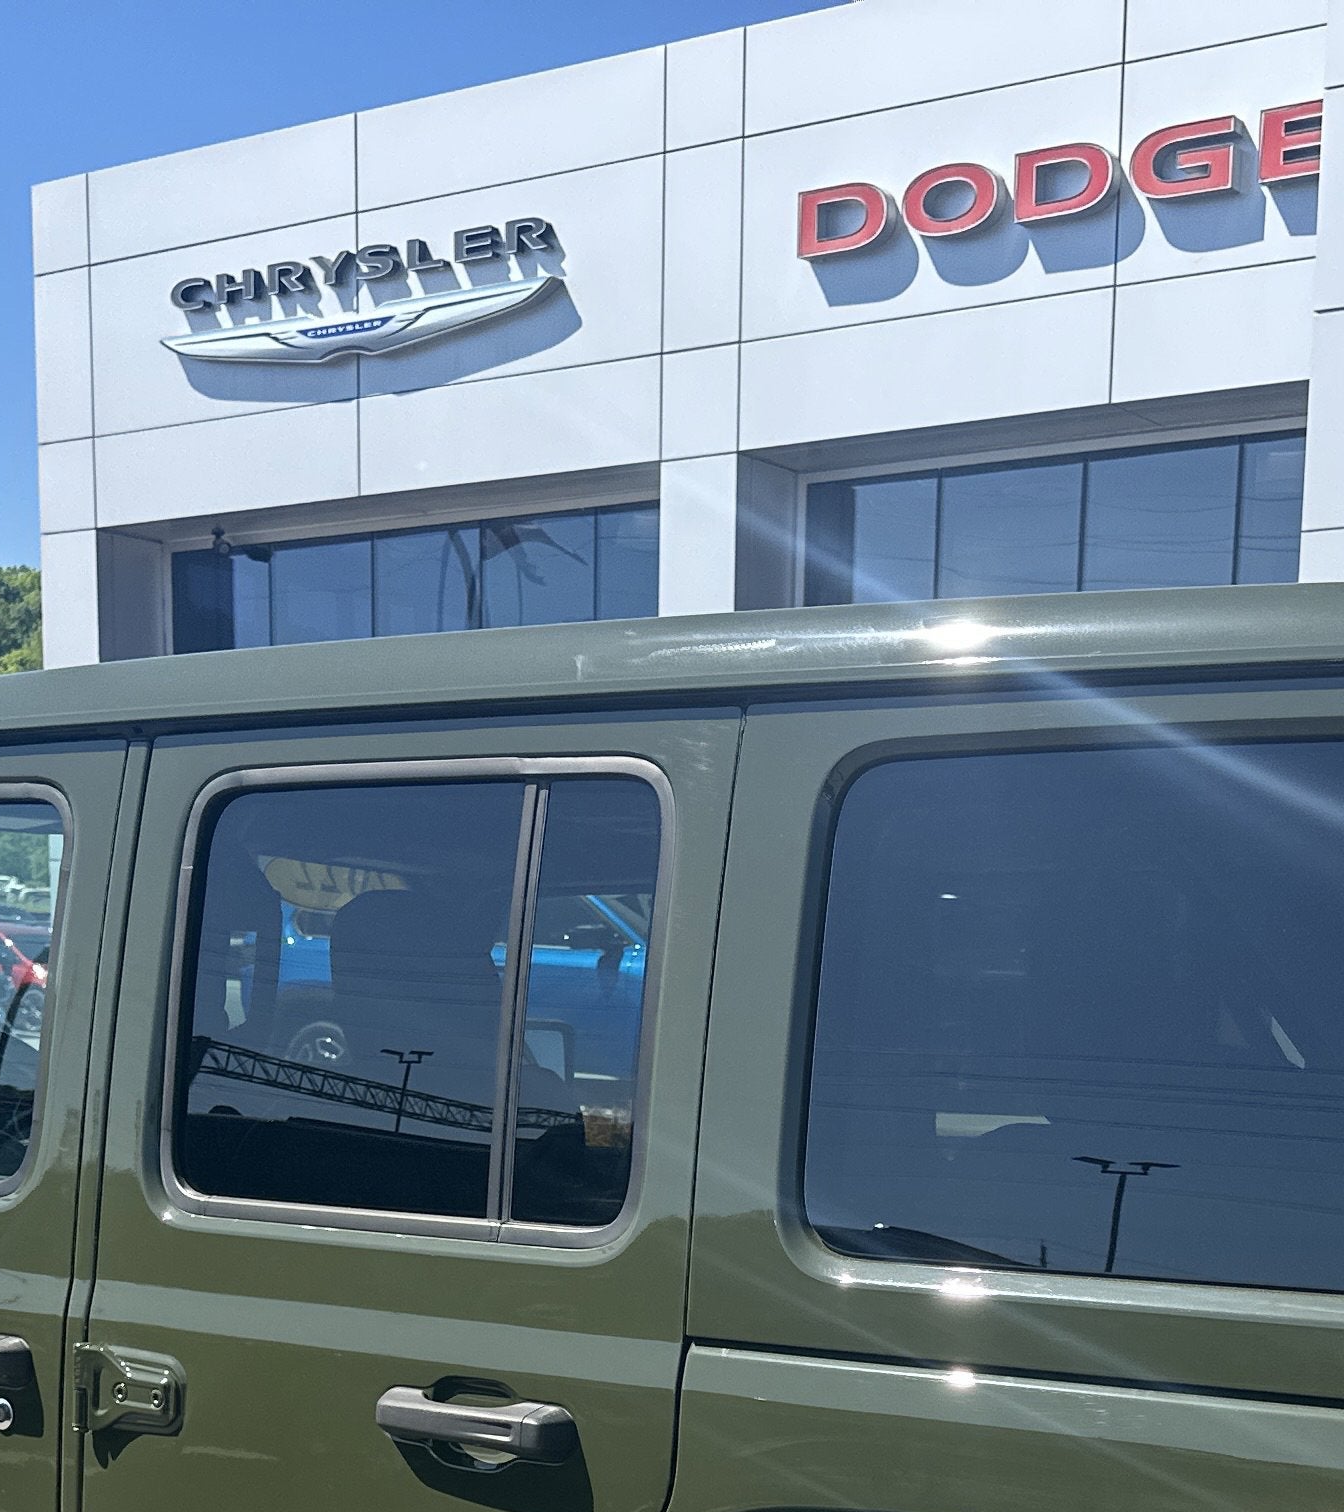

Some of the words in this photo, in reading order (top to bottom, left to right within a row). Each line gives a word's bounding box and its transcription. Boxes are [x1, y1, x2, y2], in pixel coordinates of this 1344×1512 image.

[798, 99, 1323, 259] DODGE
[170, 217, 553, 311] CHRYSLER
[307, 320, 382, 337] CHRYSLER
